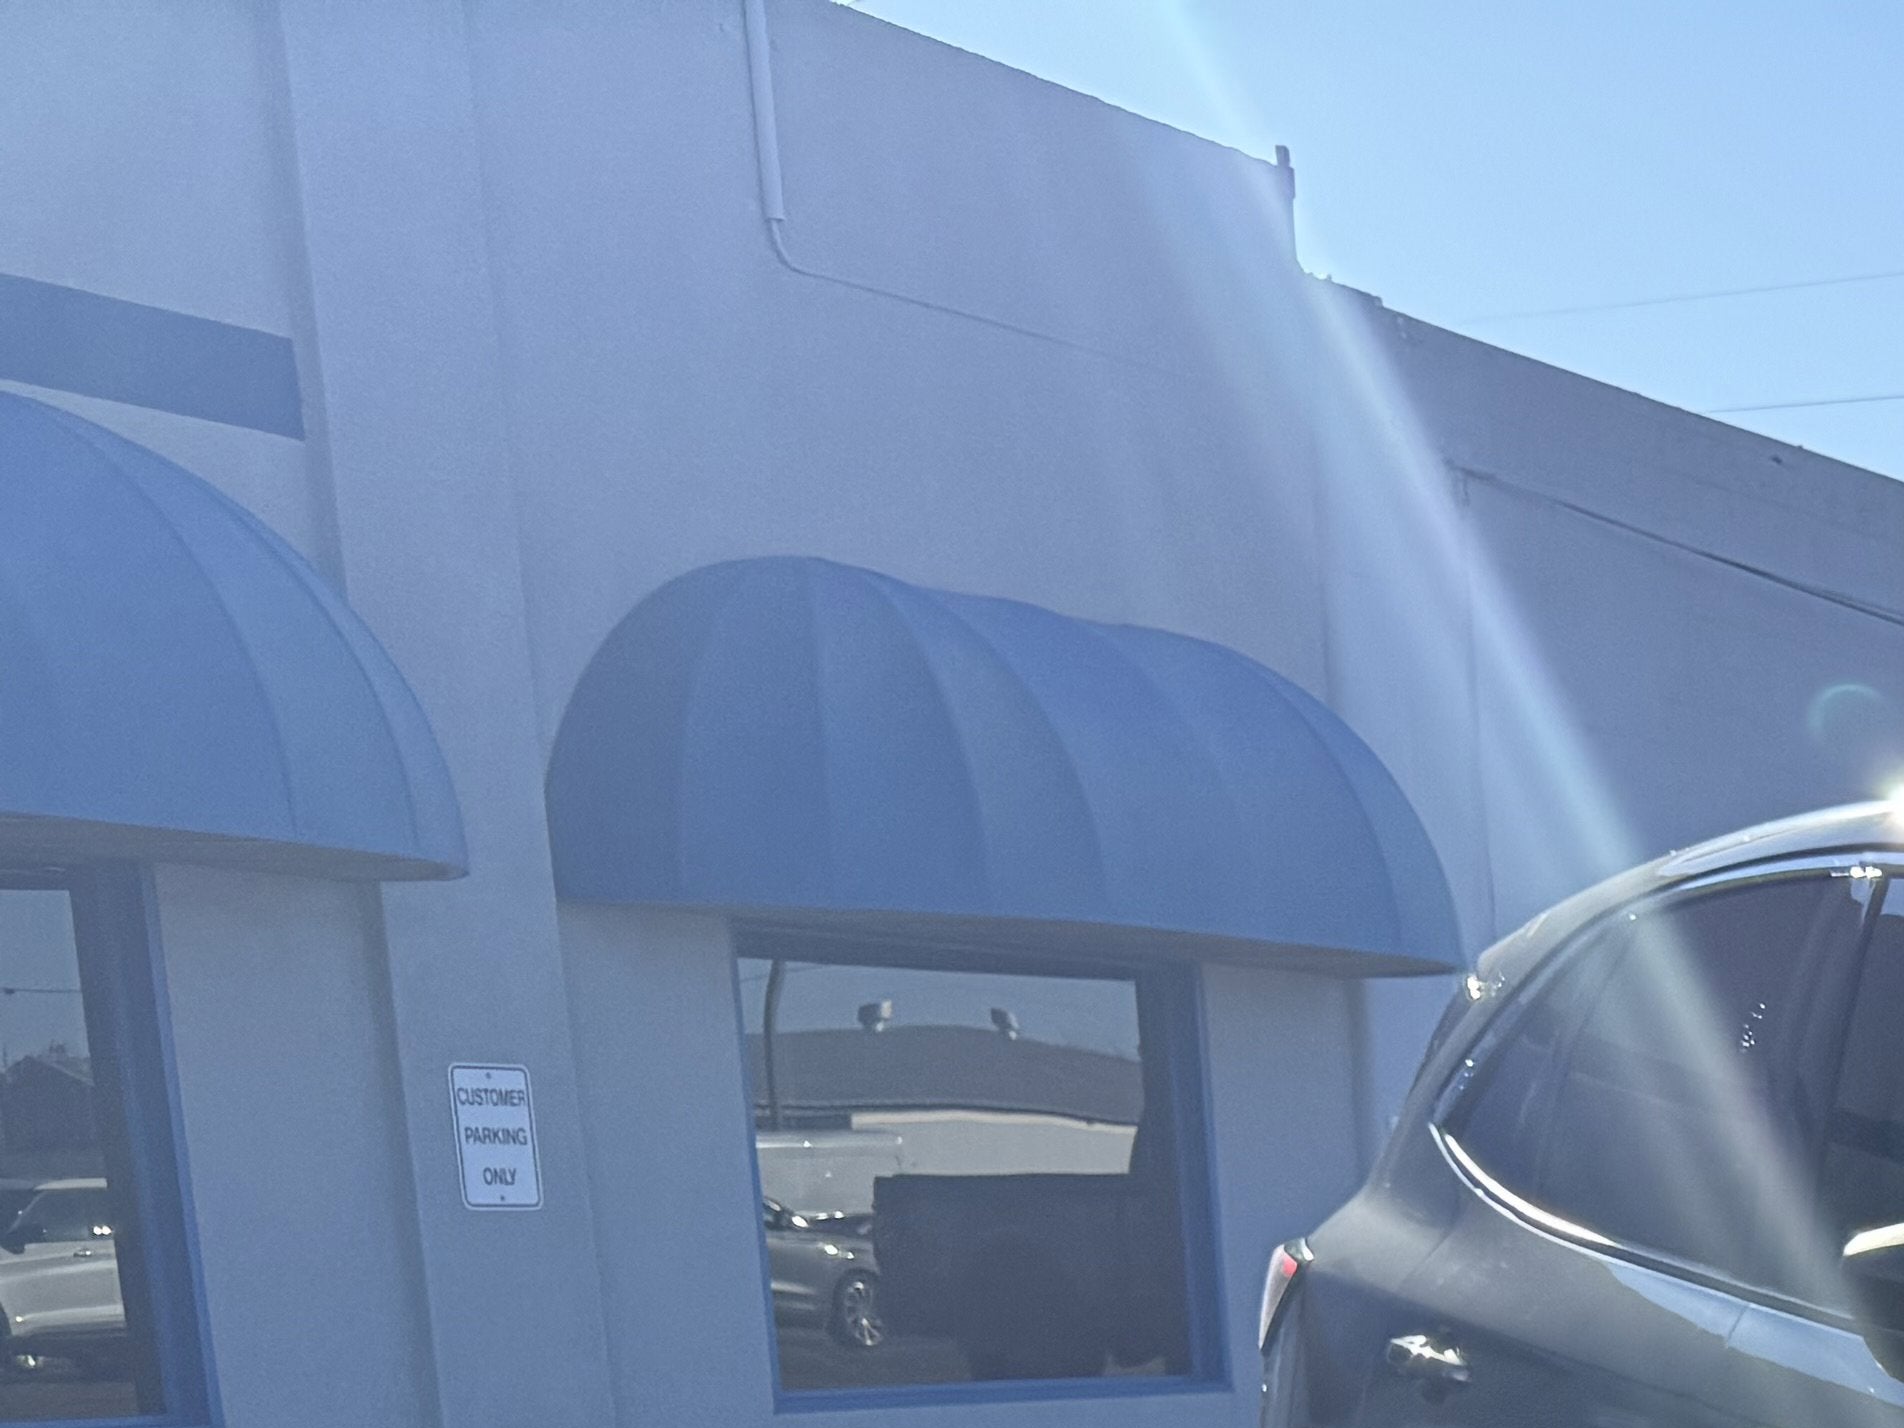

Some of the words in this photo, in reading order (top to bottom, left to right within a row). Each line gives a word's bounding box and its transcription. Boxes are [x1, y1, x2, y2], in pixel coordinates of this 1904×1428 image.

[457, 1087, 525, 1107] CUSTOMER
[464, 1127, 528, 1146] PARKING
[482, 1167, 517, 1186] ONLY
